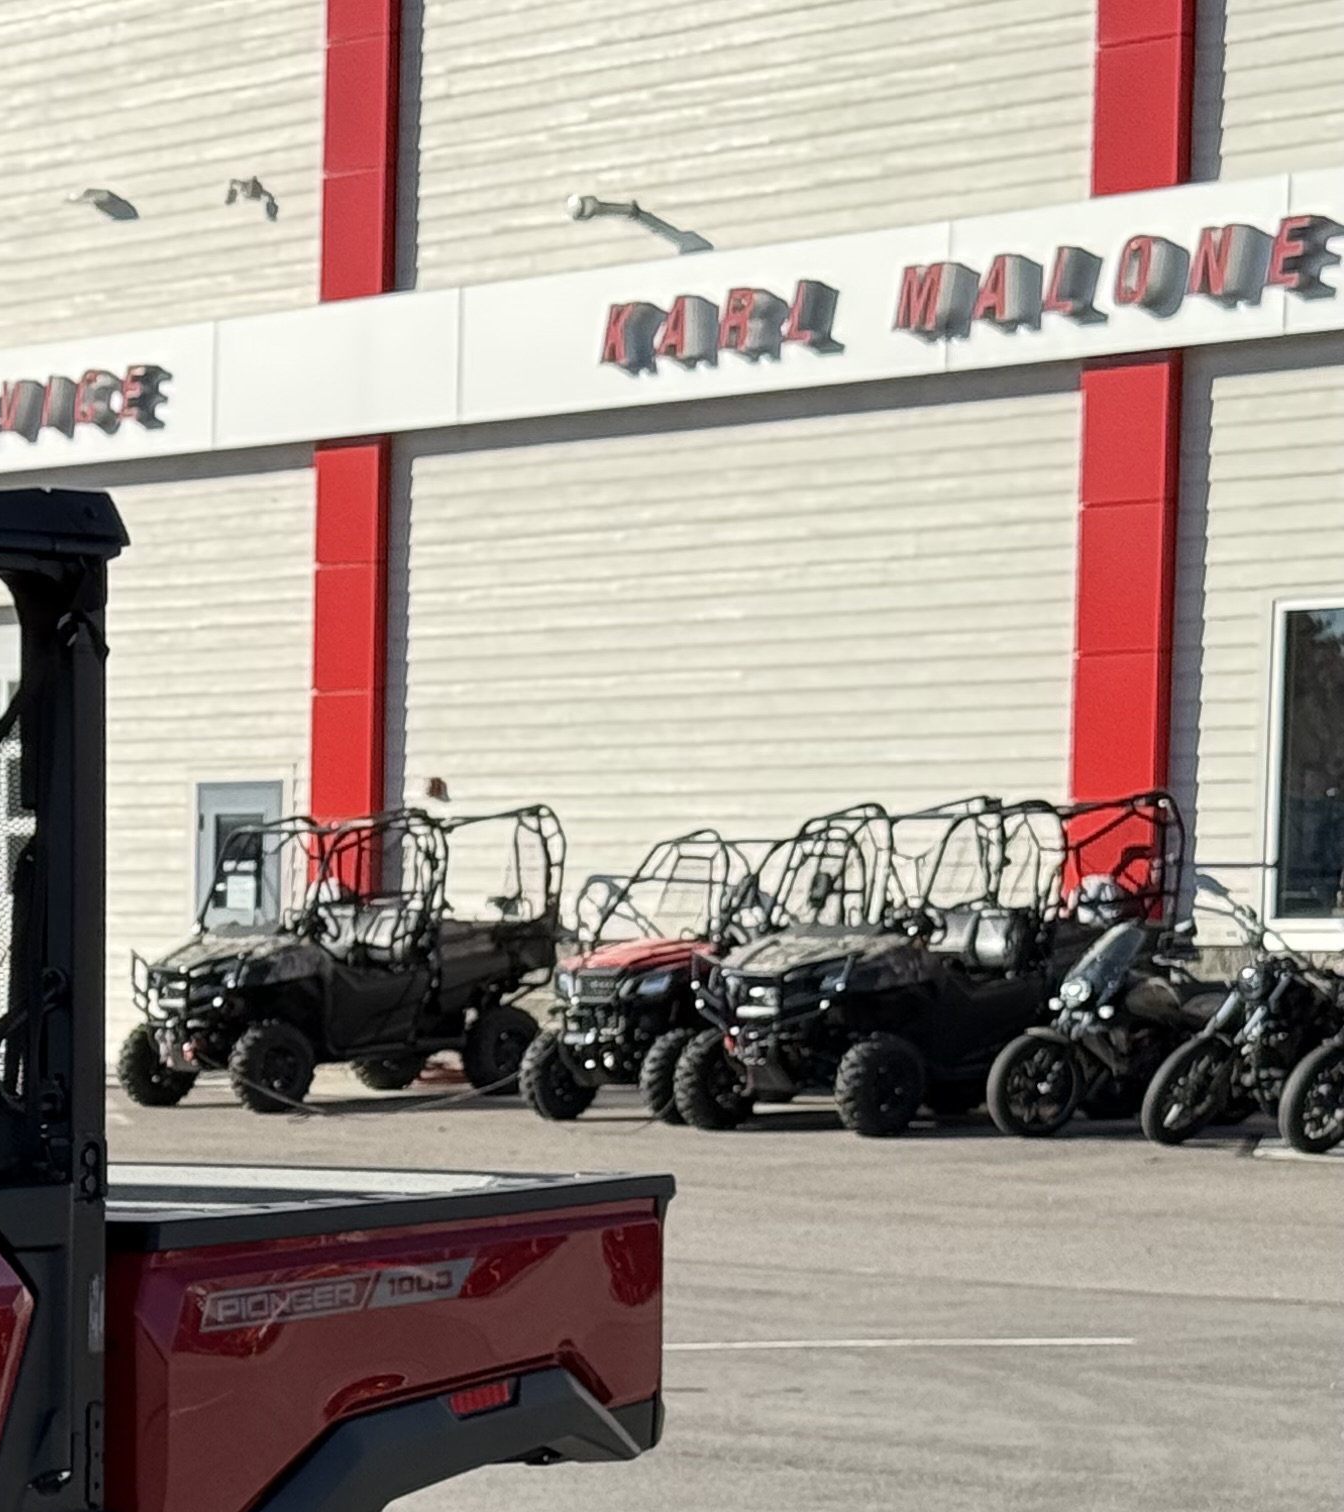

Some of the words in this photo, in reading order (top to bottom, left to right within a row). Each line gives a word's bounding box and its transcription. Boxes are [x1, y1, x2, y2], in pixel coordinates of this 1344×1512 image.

[600, 279, 845, 377] KARL
[892, 214, 1344, 344] MALONE
[216, 1281, 358, 1323] PIONEER
